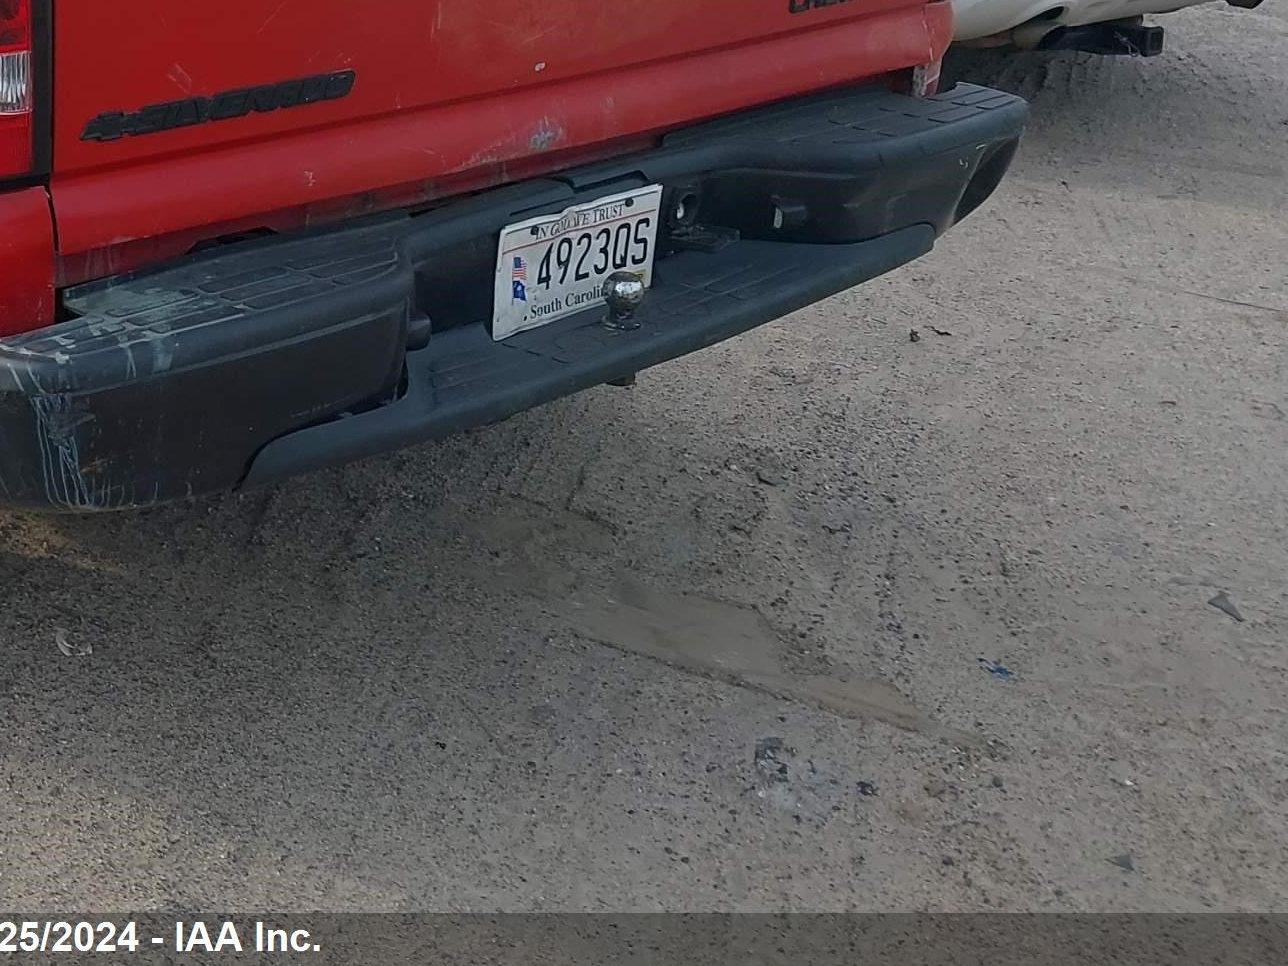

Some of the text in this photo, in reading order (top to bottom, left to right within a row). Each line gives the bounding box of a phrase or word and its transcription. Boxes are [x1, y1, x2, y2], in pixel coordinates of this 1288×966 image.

[593, 203, 625, 223] TRUST
[537, 217, 651, 291] 4923QS
[530, 285, 604, 319] South Caroli
